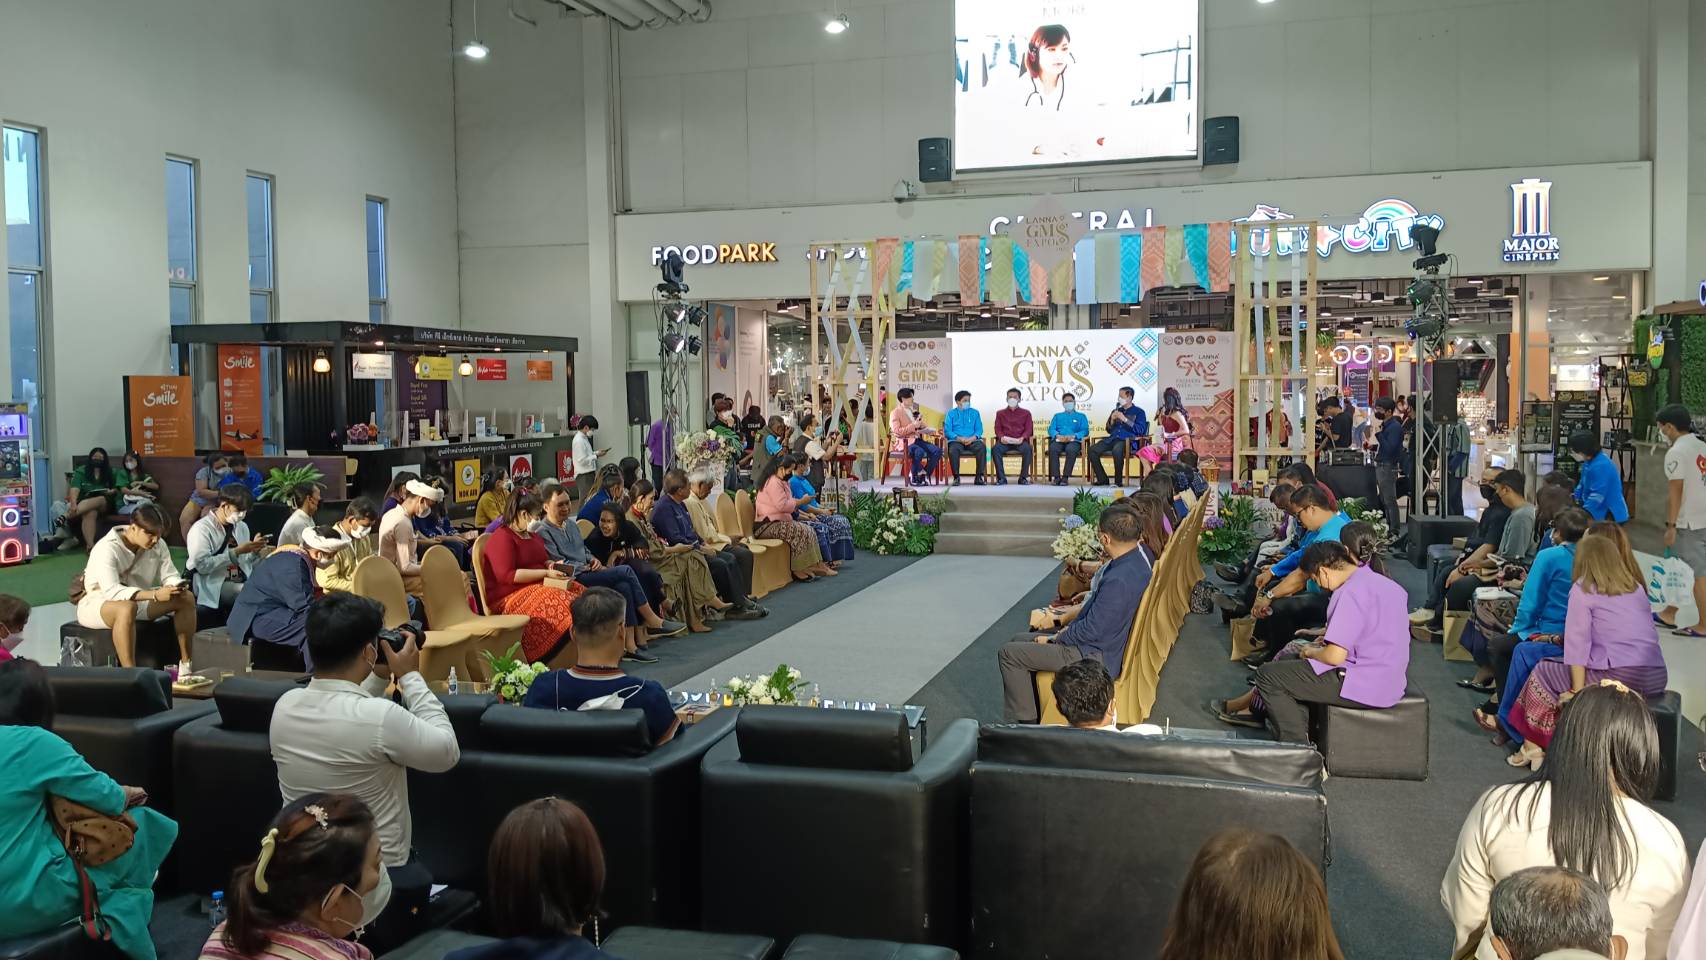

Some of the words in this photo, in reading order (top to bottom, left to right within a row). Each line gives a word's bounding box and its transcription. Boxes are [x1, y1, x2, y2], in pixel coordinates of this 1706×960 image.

[1026, 216, 1057, 224] LANNA
[1026, 223, 1070, 246] GMS
[1503, 237, 1560, 253] MAJOR
[1503, 252, 1560, 262] CINEPLEX
[1012, 345, 1072, 359] LANNA
[223, 355, 255, 369] Smile
[898, 369, 938, 382] GMS
[1012, 356, 1094, 403] GMS
[143, 391, 179, 407] Smile
[1020, 386, 1066, 402] XPO
[459, 489, 469, 498] NOK
